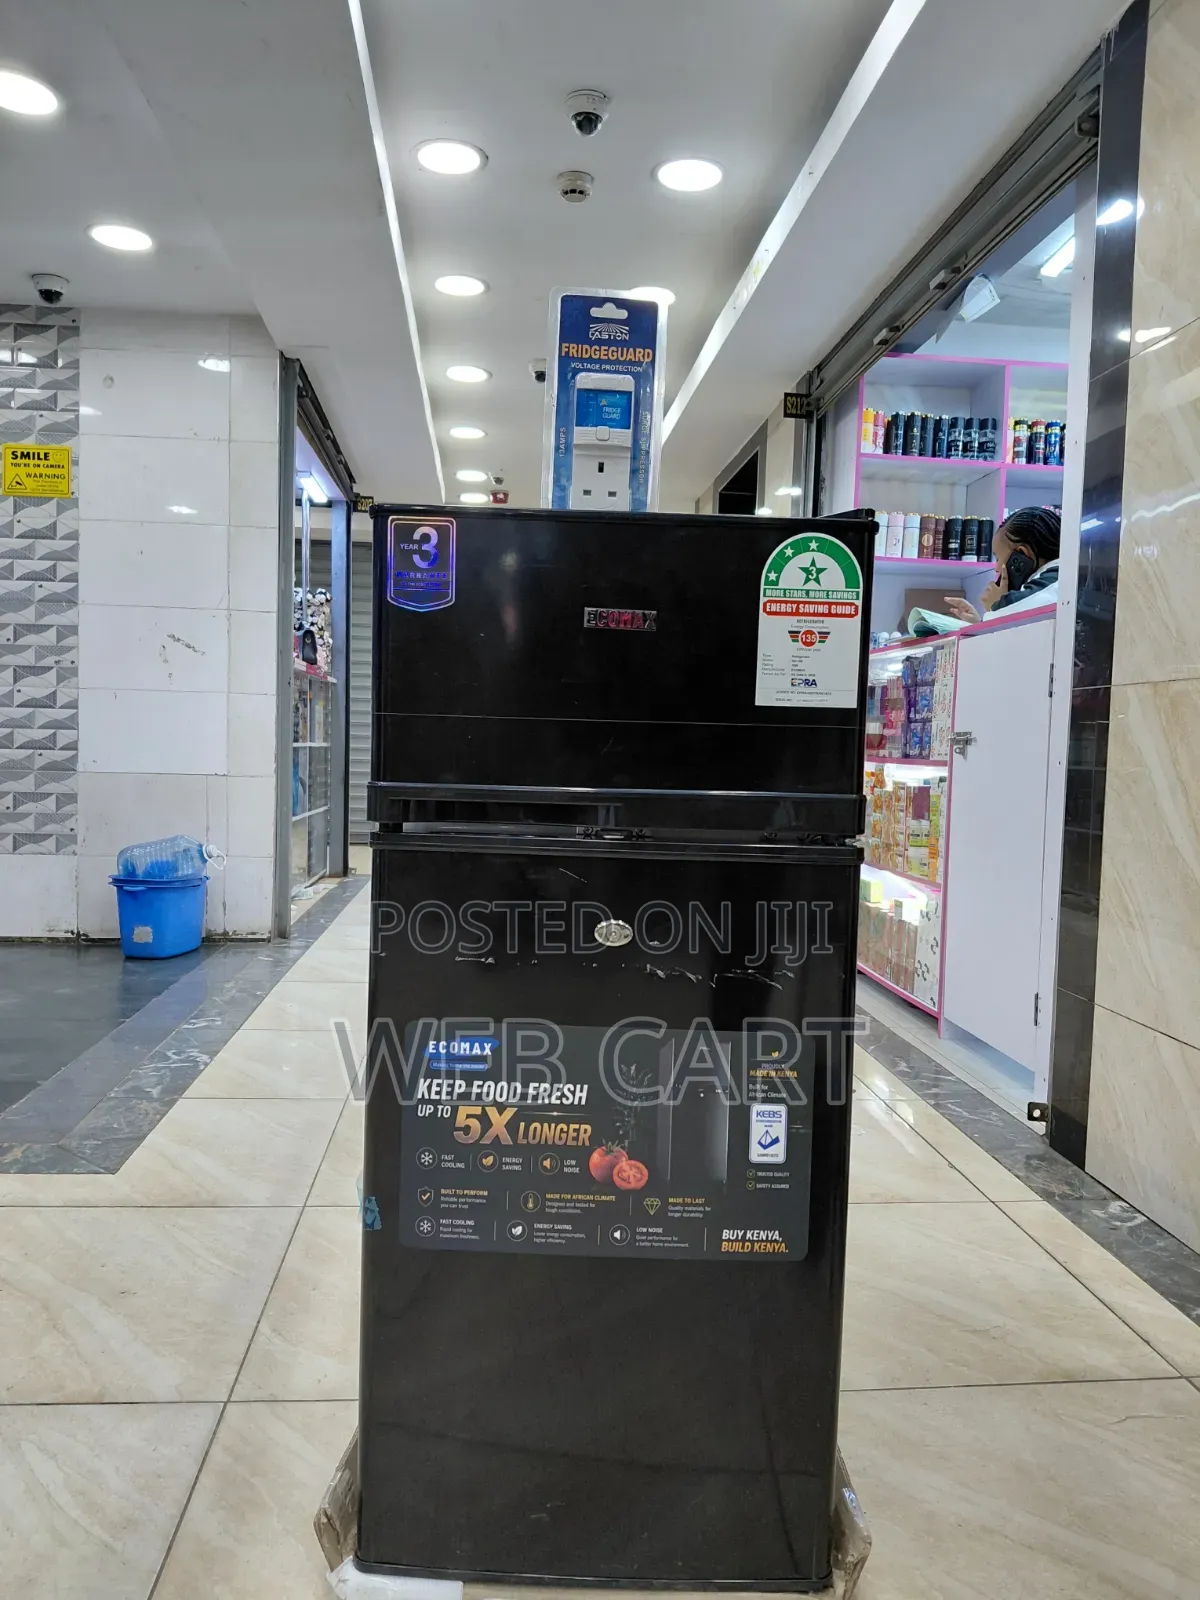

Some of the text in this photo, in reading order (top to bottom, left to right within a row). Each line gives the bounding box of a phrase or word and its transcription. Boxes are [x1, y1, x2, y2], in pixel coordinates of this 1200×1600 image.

[562, 343, 652, 362] FRIDGEGUARD
[11, 450, 50, 461] SMILE
[413, 527, 438, 568] 3
[809, 567, 816, 579] 3
[786, 590, 807, 598] STARS,
[828, 591, 856, 599] SAVINGS
[766, 603, 855, 614] ENERGY SAVING GUIDE
[791, 678, 817, 686] EPRA
[429, 1041, 492, 1055] ECOMAX
[417, 1078, 588, 1106] KEEP FOOD FRESH
[756, 1110, 782, 1118] KEBS
[417, 1105, 592, 1146] UP TO 5X LONGER
[722, 1229, 782, 1242] BUY KENYA,
[721, 1242, 788, 1252] BUILD KENYA.
